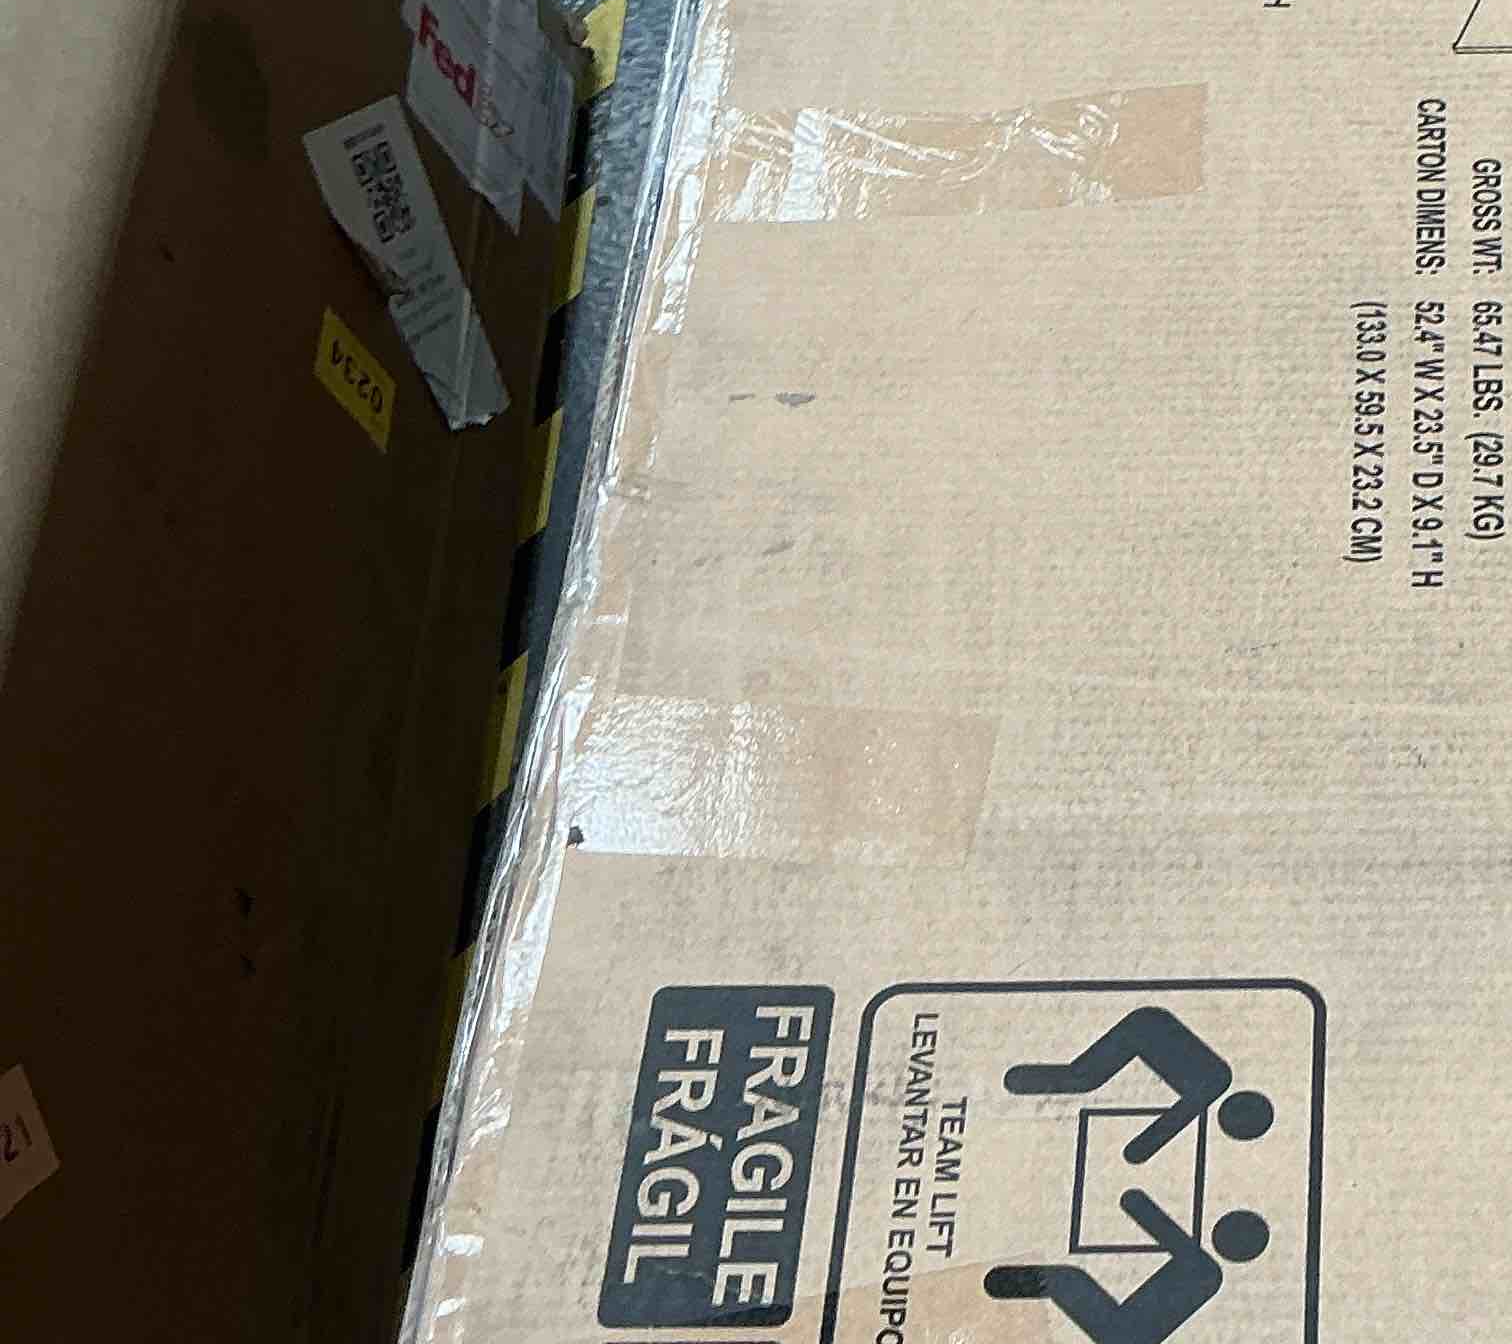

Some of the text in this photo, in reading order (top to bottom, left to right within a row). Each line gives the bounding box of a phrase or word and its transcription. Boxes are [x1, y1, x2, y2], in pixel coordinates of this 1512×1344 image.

[1343, 302, 1387, 563] (133.0 X 59.5 X 23.2 CM)
[1411, 98, 1447, 587] CARTON DIMENS: 52.4" W X 23.5" D X 9.1" H
[1464, 158, 1505, 541] GROSS WT: 65.47 LBS. (29.7 KG)
[624, 1028, 725, 1285] FRÁGIL
[711, 1006, 816, 1307] FRAGILE
[892, 1176, 921, 1219] EN
[895, 1012, 939, 1169] LEVANTAR
[926, 1096, 967, 1258] TEAM LIFT
